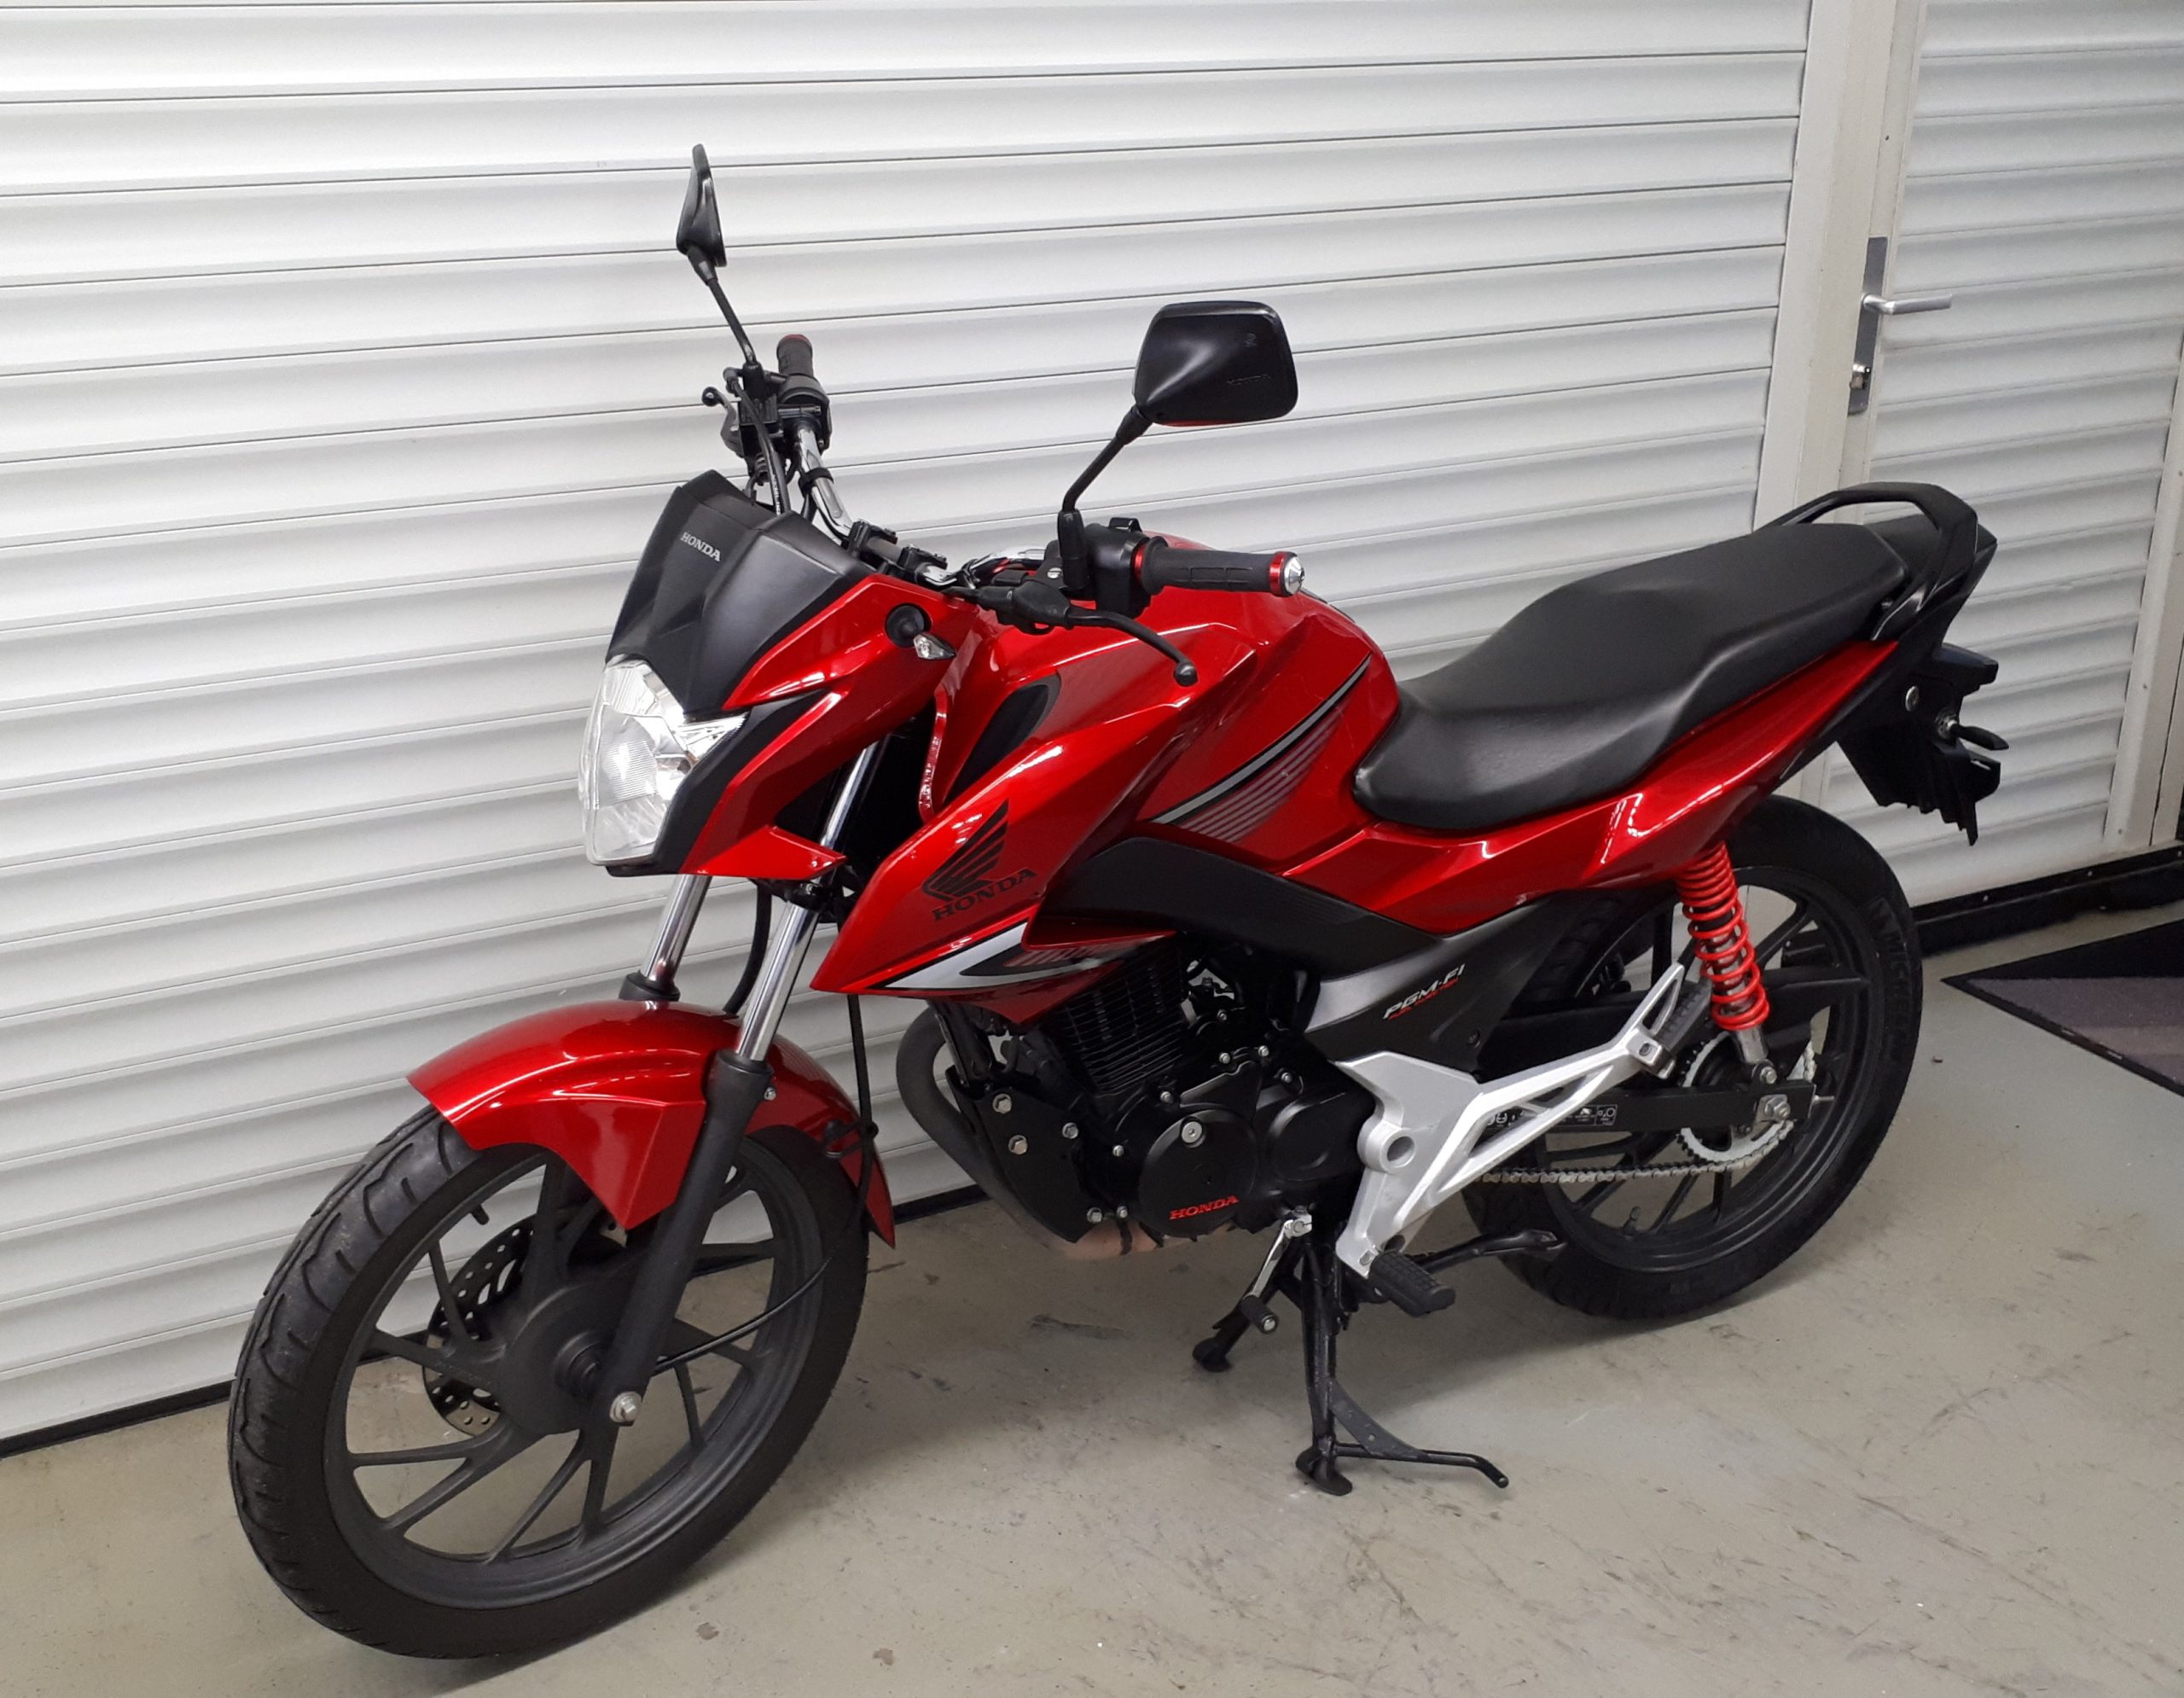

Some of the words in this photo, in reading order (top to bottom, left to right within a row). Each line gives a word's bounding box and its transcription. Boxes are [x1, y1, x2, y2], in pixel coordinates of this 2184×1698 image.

[680, 532, 722, 562] HONDA
[932, 868, 1038, 922] HONDA
[1169, 1195, 1240, 1220] HONDA
